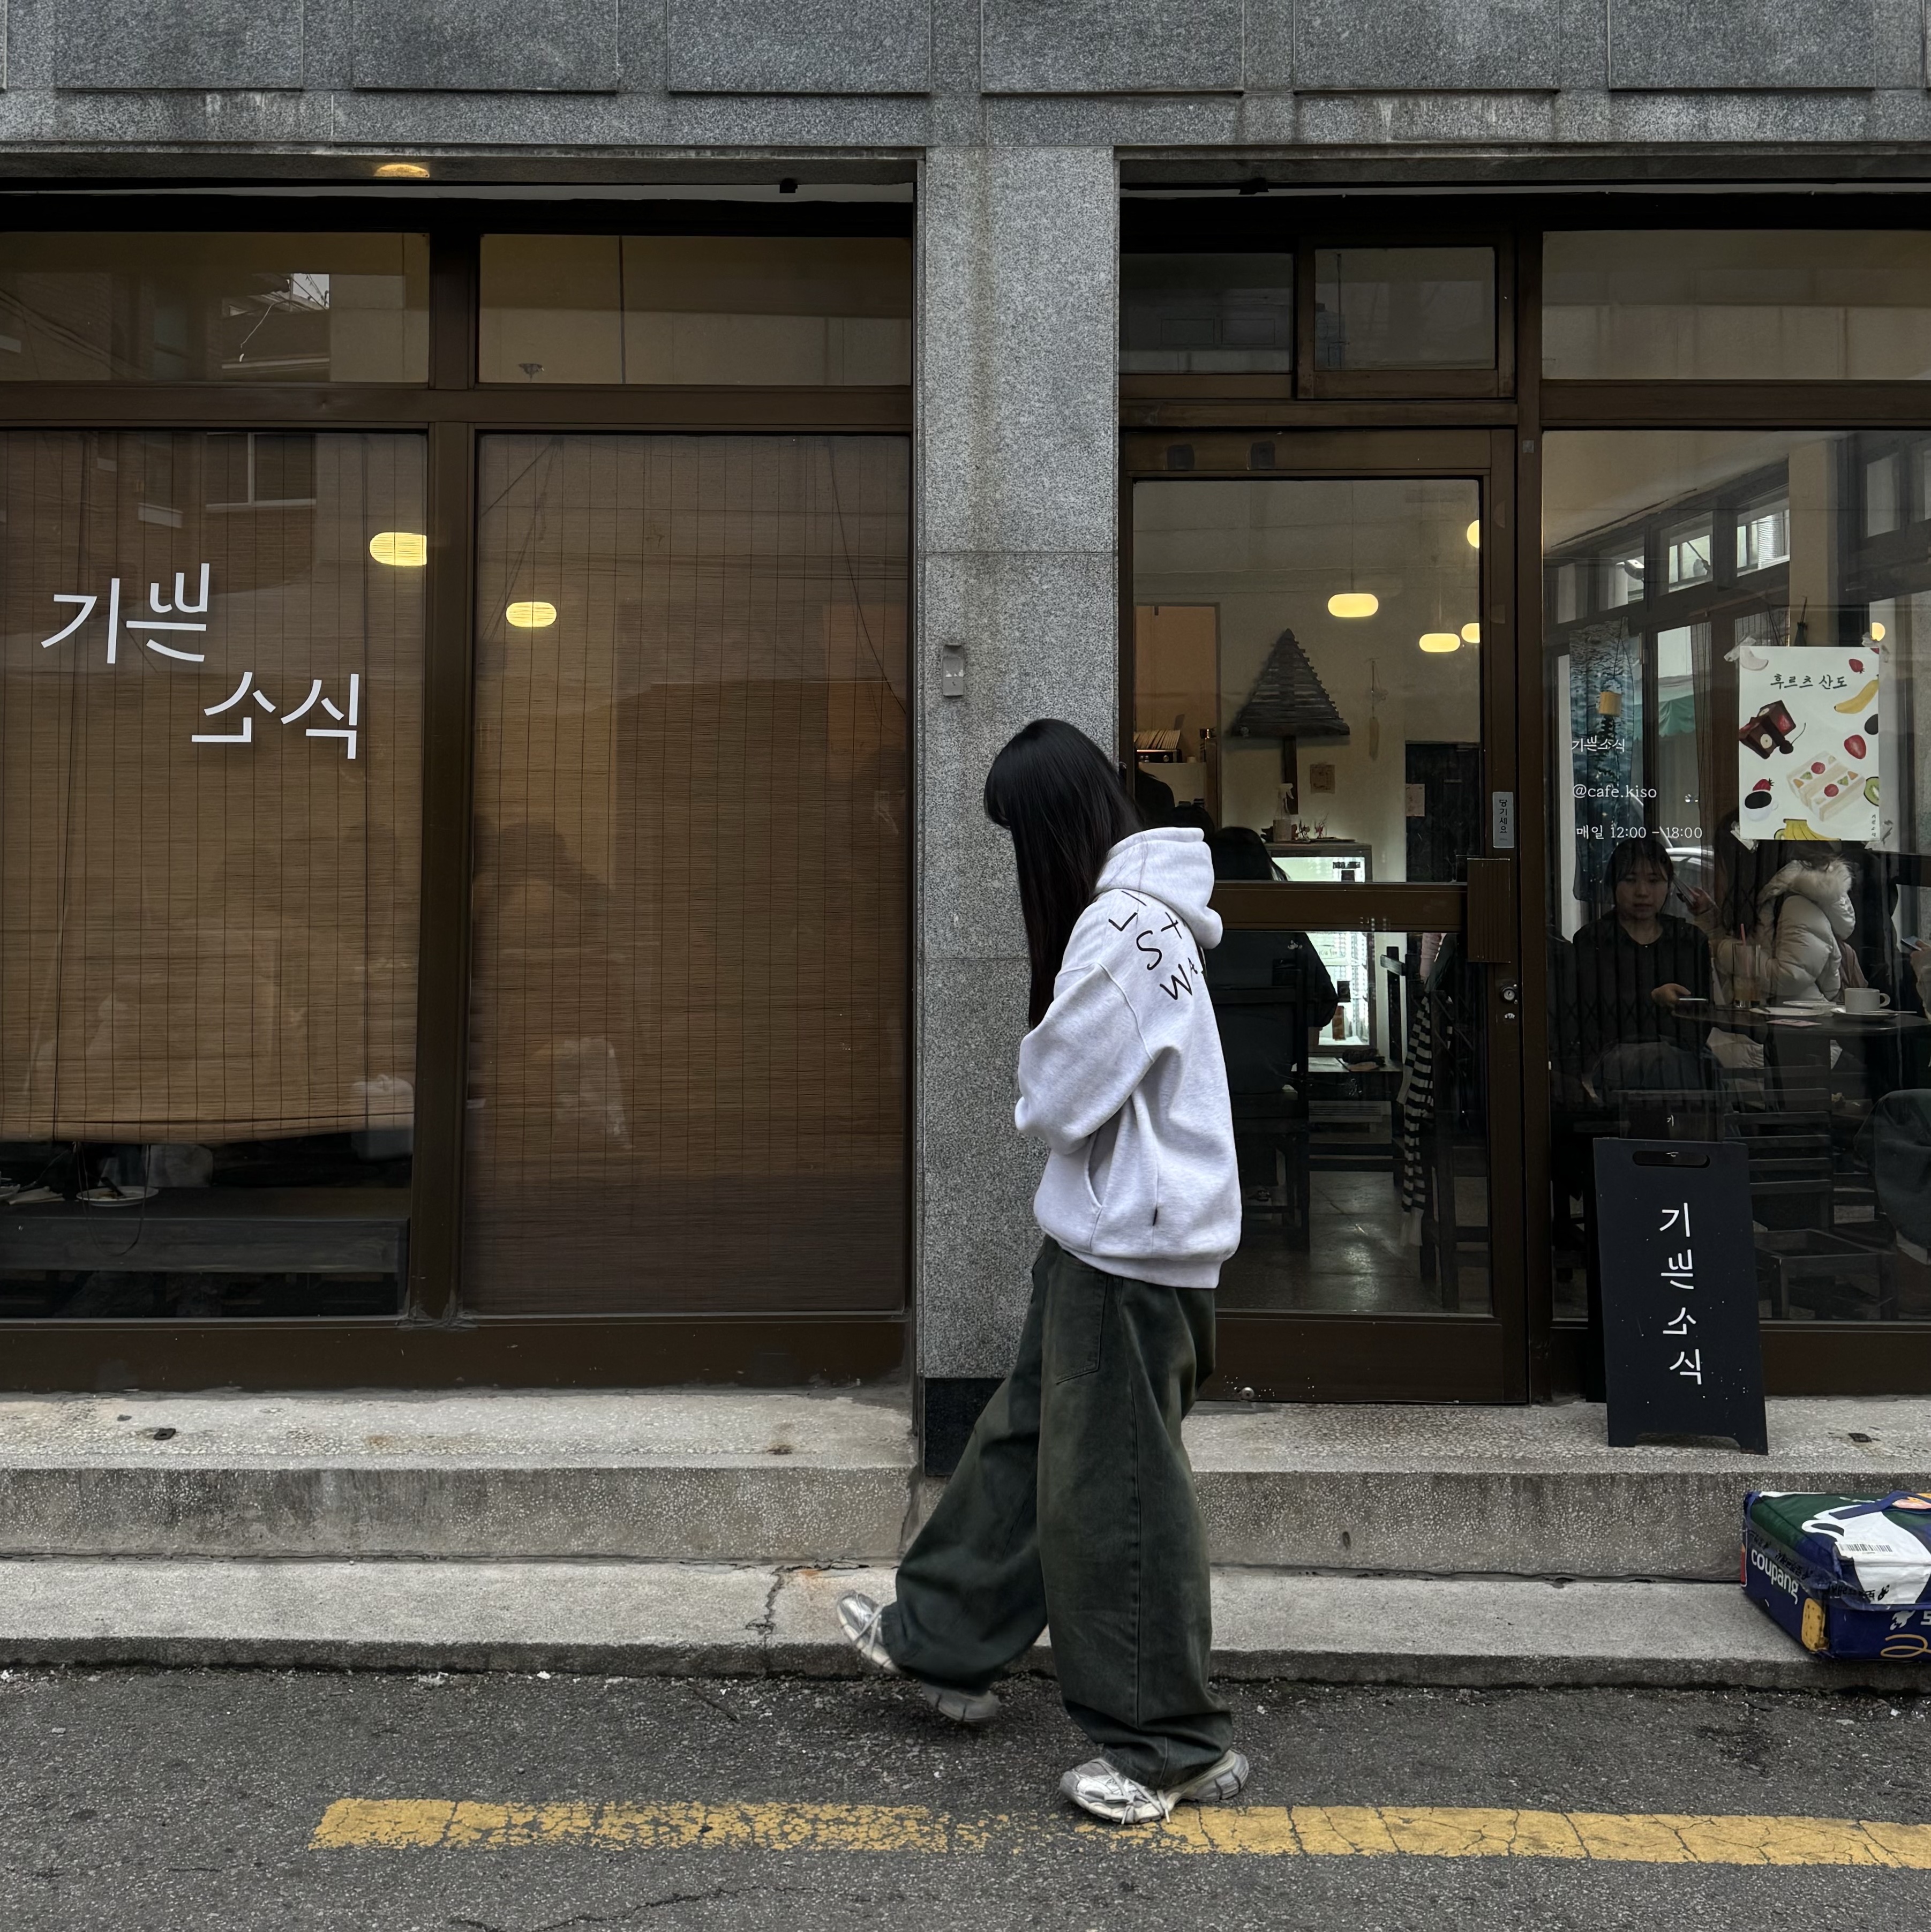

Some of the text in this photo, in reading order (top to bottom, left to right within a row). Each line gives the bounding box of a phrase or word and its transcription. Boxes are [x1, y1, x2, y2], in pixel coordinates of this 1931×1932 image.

[41, 563, 210, 664] 기쁜
[1770, 673, 1847, 690] 후르츠 산도
[192, 672, 359, 759] 소식
[1572, 735, 1625, 753] 기쁜소식
[1573, 784, 1657, 798] @cafe.kiso
[1499, 799, 1507, 833] 당기세요
[1576, 825, 1604, 839] 매일
[1610, 826, 1647, 838] 12:00
[1666, 826, 1702, 838] 18:00
[1751, 1549, 1799, 1605] coupang
